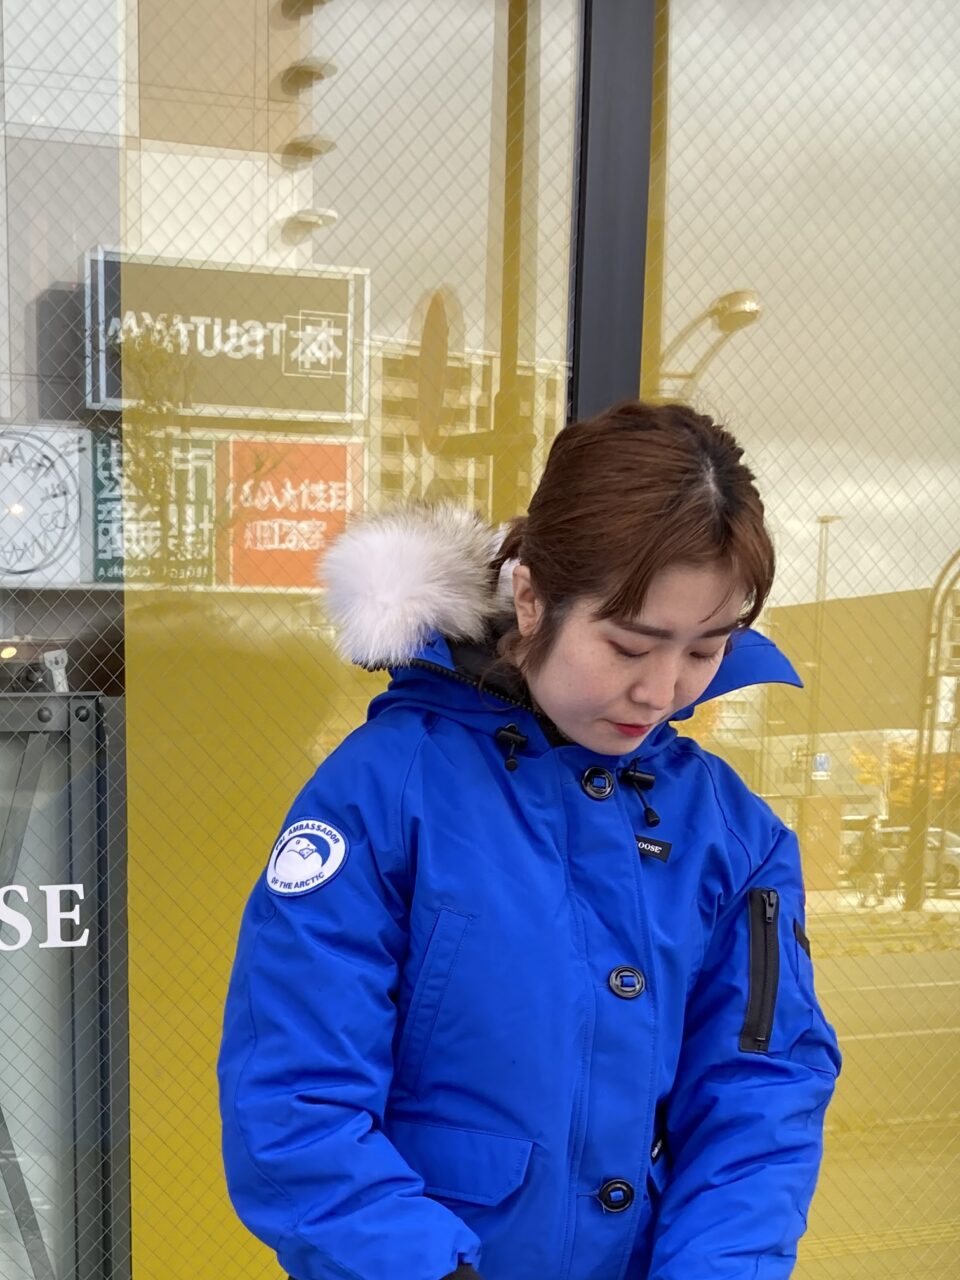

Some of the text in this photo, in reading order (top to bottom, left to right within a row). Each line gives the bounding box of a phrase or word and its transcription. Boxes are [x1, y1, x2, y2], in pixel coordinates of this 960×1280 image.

[288, 822, 340, 844] AMBASSADOR
[637, 841, 662, 853] OOSE
[271, 871, 326, 890] OF THE ARCTIC
